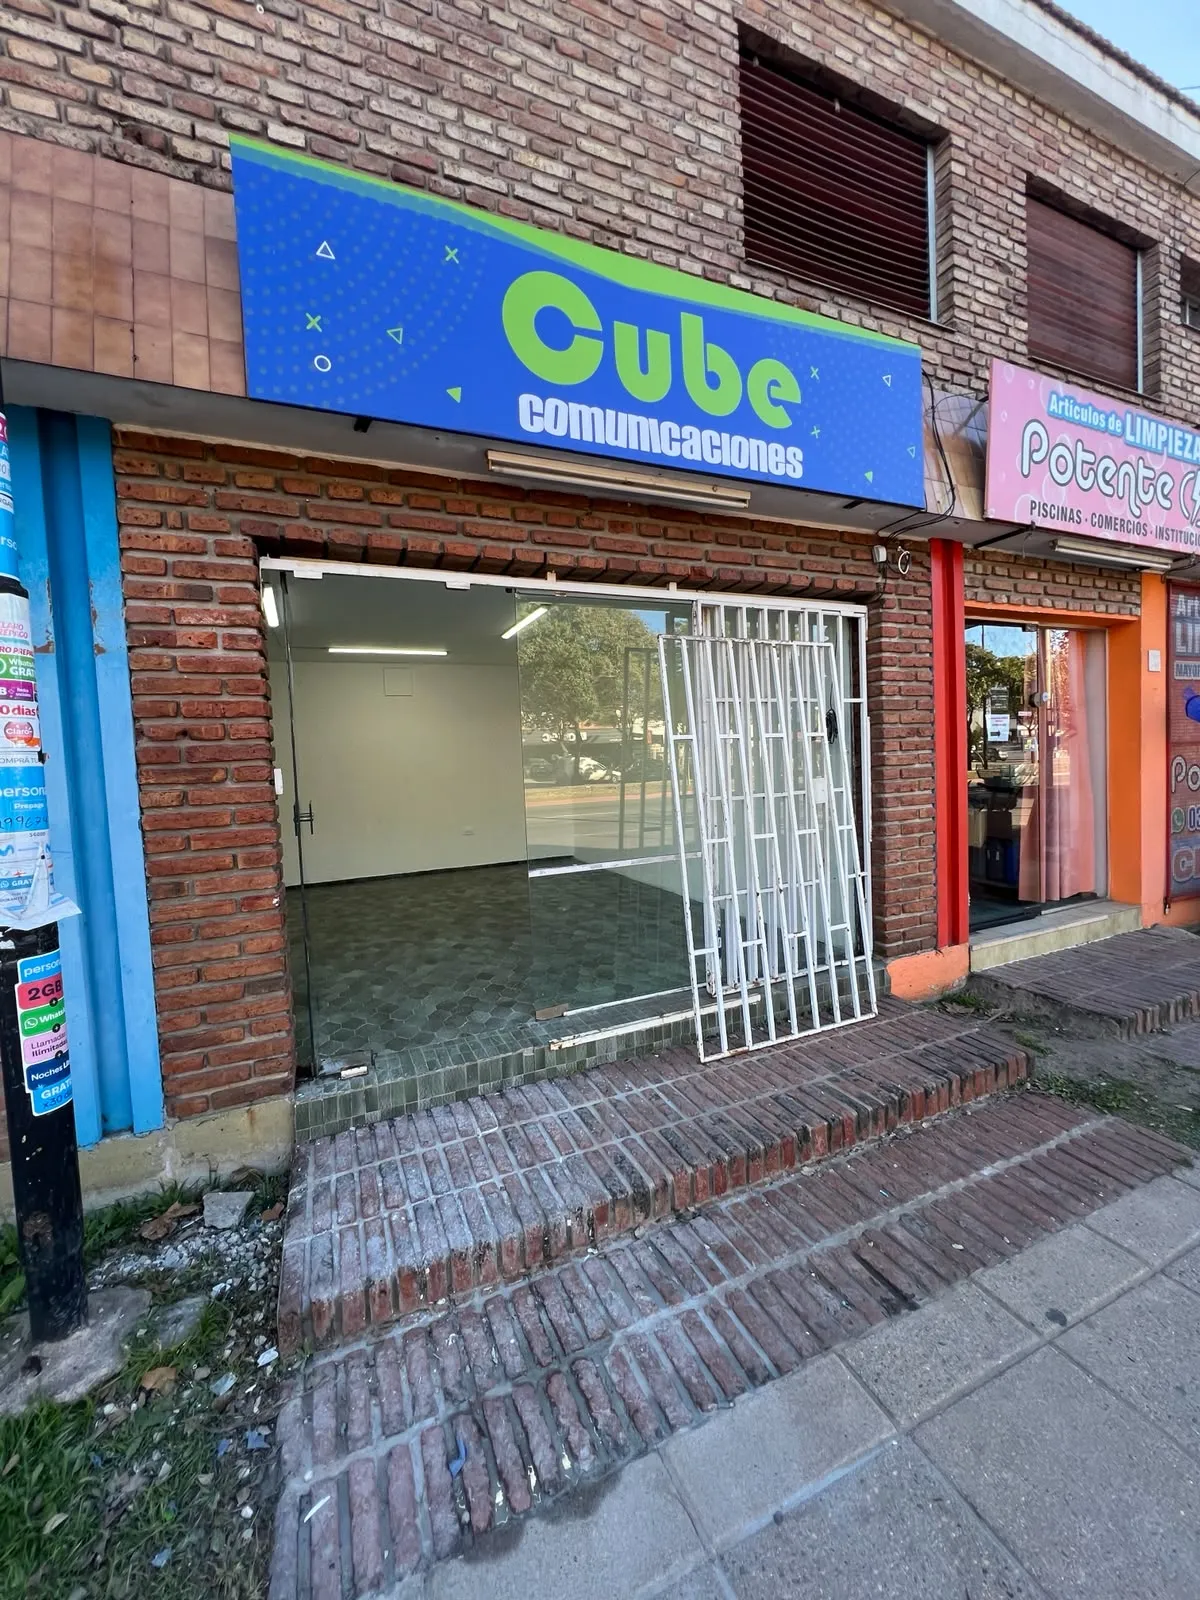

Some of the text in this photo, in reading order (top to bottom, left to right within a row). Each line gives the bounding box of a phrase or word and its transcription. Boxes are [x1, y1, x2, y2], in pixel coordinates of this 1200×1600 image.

[502, 270, 801, 429] Cube
[1049, 394, 1106, 428] Artículos
[1107, 413, 1122, 433] de
[1021, 419, 1175, 519] Potente
[1029, 499, 1082, 525] PISCINAS
[1090, 512, 1148, 537] COMERCIOS
[5, 726, 32, 736] Claro
[28, 979, 62, 1001] 2GB
[31, 1065, 63, 1082] Noches
